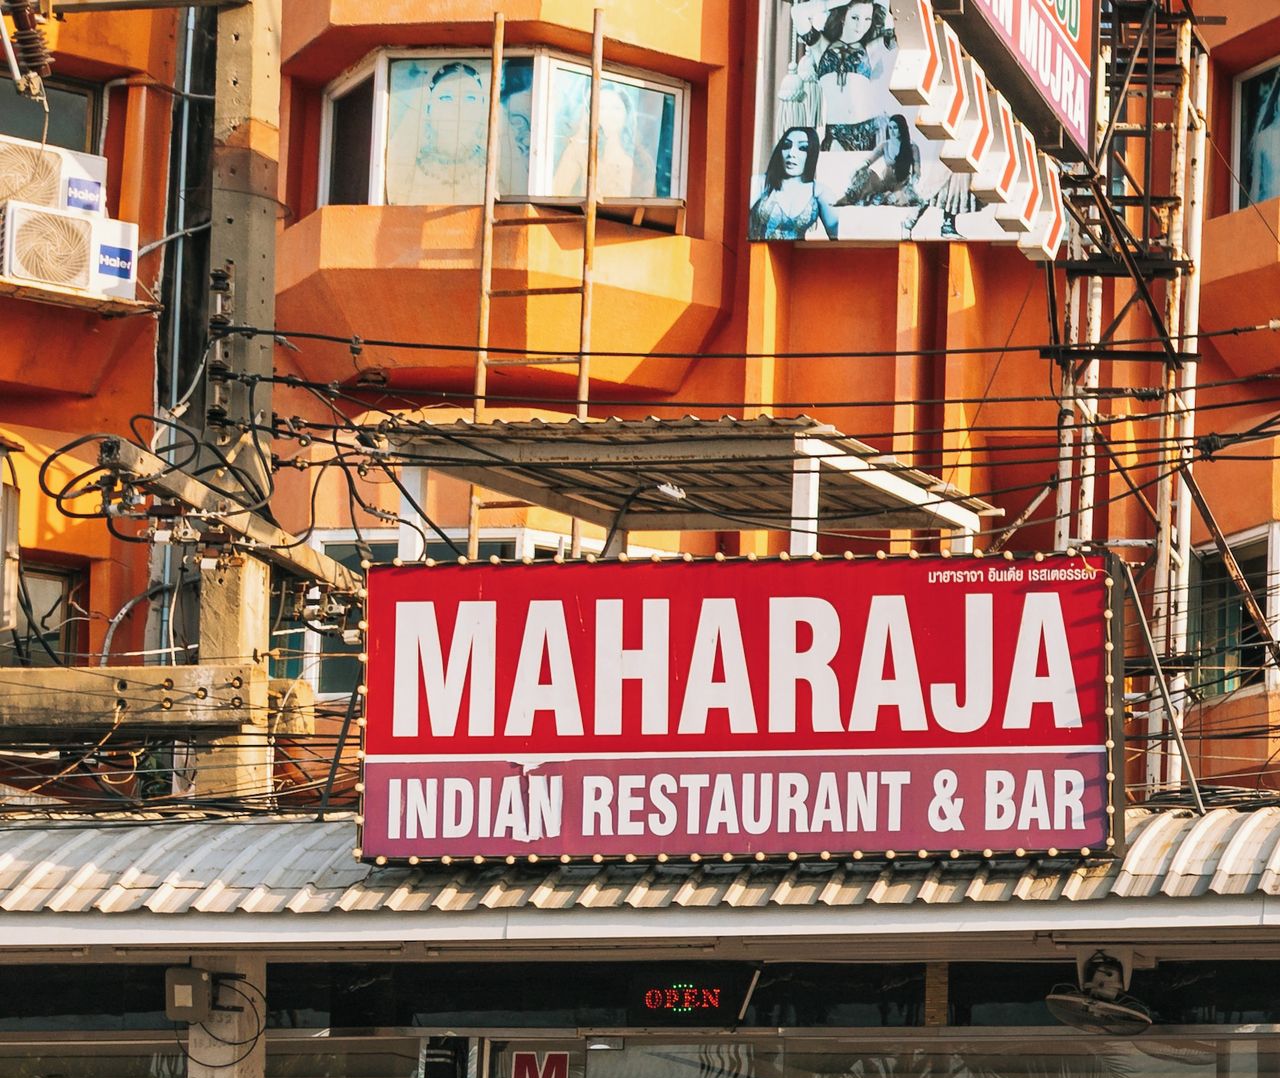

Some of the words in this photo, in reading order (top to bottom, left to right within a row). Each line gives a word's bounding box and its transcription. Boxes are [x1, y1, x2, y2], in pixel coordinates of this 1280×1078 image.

[1020, 0, 1085, 139] MUJRA
[68, 187, 99, 200] Haier
[100, 254, 131, 269] Haier
[393, 592, 1083, 738] MAHARAJA
[387, 775, 562, 842] INDIAN
[581, 770, 910, 837] RESTAURANT
[927, 771, 965, 833] &
[985, 769, 1088, 832] BAR
[645, 988, 720, 1009] OPEN
